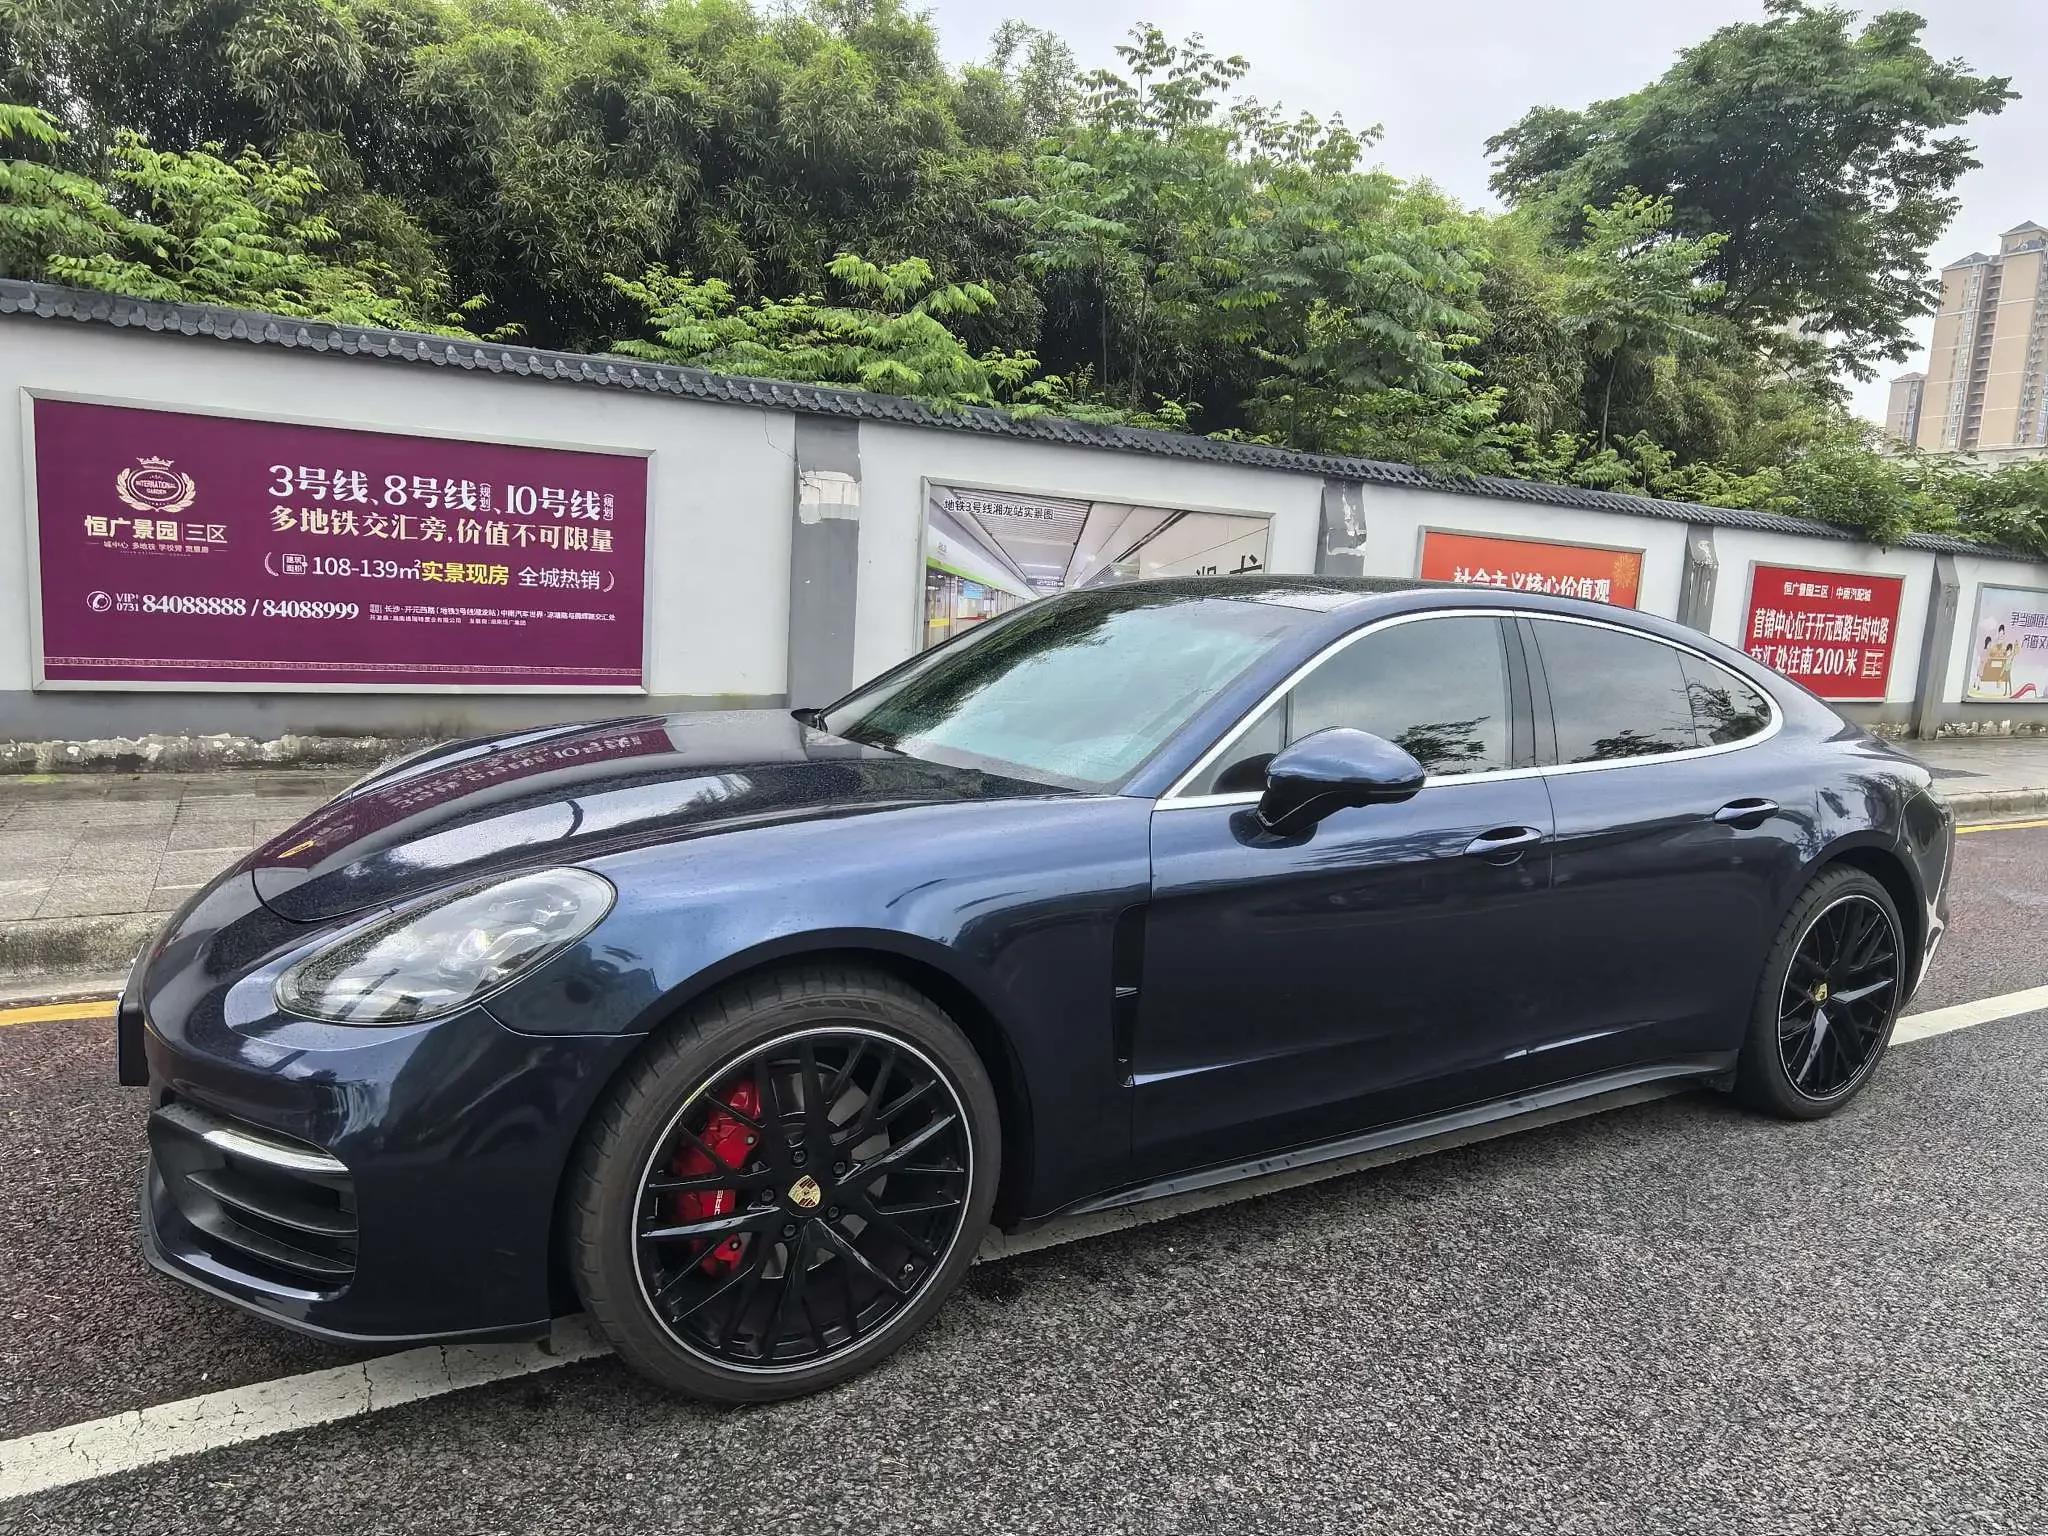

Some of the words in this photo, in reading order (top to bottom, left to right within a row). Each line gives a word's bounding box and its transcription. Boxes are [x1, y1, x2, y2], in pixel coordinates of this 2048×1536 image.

[136, 480, 177, 489] INTERNATIONAL
[944, 499, 1054, 520] 地铁3号线湘龙站实景图
[84, 514, 178, 541] 恒广景园
[185, 523, 228, 543] 三区
[518, 566, 601, 590] 全城热销
[1453, 565, 1611, 603] 社会主义核心价值观
[116, 602, 139, 612] 0731
[142, 594, 247, 616] 84088888
[263, 599, 359, 620] 84088999
